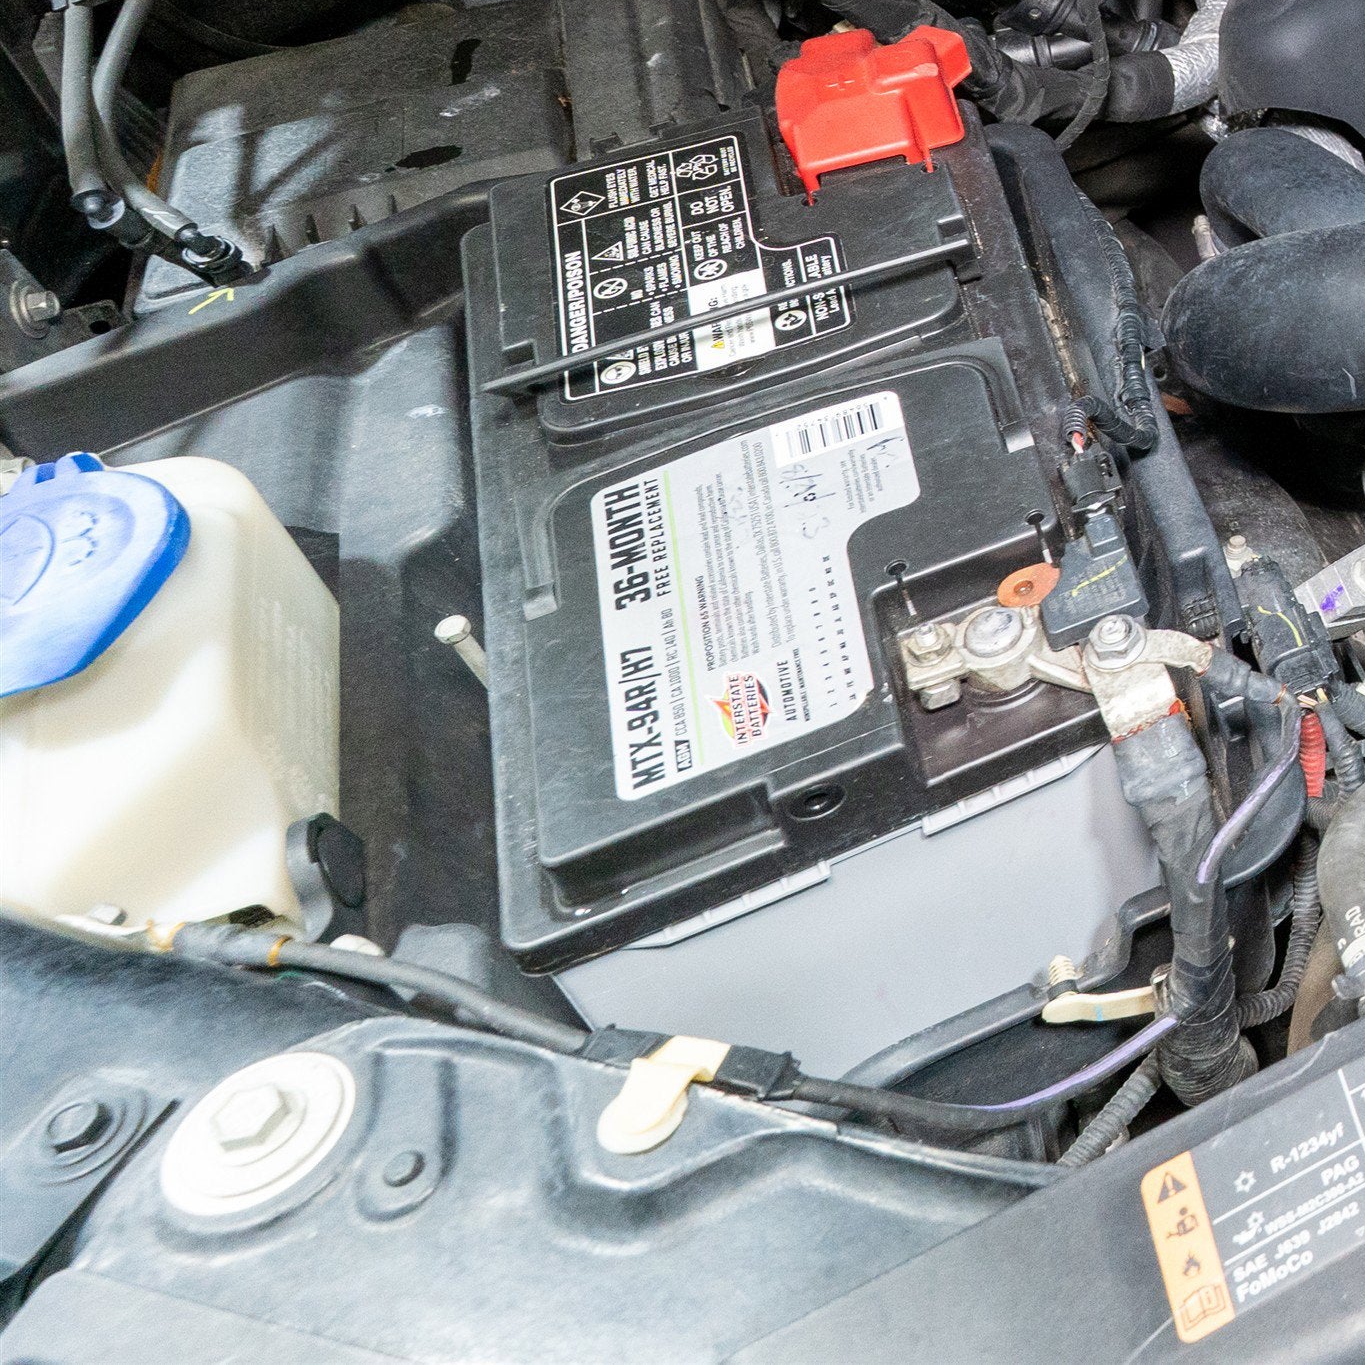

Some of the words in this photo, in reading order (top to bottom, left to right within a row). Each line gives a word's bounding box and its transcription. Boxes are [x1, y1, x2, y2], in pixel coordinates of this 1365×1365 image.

[605, 172, 615, 188] EYES
[627, 166, 637, 188] WATER.
[646, 159, 656, 185] MEDICAL
[607, 188, 617, 208] FLUSH
[616, 169, 629, 205] IMMEDIATELY
[629, 187, 639, 203] WITH
[649, 185, 658, 197] GET
[659, 179, 669, 195] HELP
[690, 201, 704, 215] DO
[704, 195, 718, 214] NOT
[719, 185, 734, 212] OPEN.
[650, 207, 660, 217] OR
[639, 220, 650, 240] CAUSE
[652, 217, 664, 251] BLINDNESS
[666, 223, 677, 247] SEVERE
[691, 231, 701, 243] OUT
[718, 223, 728, 231] OF
[732, 217, 745, 249] CHILDREN.
[641, 240, 651, 254] CAN
[705, 234, 716, 247] THE
[720, 230, 731, 253] REACH
[693, 244, 703, 260] KEEP
[707, 247, 718, 257] OF
[643, 266, 655, 291] SPARKS
[657, 262, 668, 288] FLAMES
[669, 254, 682, 284] SMOKING
[565, 251, 588, 352] DANGER/POISON
[650, 301, 660, 315] CAN
[826, 295, 839, 313] Lead
[678, 331, 689, 351] INJUR
[638, 352, 651, 375] SHIELD
[652, 340, 667, 370] EXPLOSIV
[667, 343, 679, 366] CAUSE
[681, 351, 692, 362] OR
[643, 479, 666, 561] REPLACEMENT
[605, 485, 650, 609] 36-MONTH
[654, 565, 670, 596] FREE
[695, 575, 706, 610] WARNING
[660, 608, 672, 619] 80
[662, 619, 673, 628] Ah
[700, 610, 709, 620] 65
[664, 634, 676, 649] 140
[701, 620, 714, 671] PROPOSITION
[665, 649, 677, 661] RC
[667, 666, 680, 686] 1000
[670, 685, 681, 697] CA
[777, 660, 796, 720] AUTOMOTIVE
[620, 646, 663, 787] MTX-94R/H7
[672, 702, 684, 719] 850
[729, 677, 746, 744] INTERSTATE
[743, 675, 761, 736] BATTERIES
[674, 718, 686, 736] CCA
[676, 740, 690, 770] AGM
[1270, 1122, 1343, 1172] R-1234yf
[1320, 1155, 1359, 1185] PAG
[1233, 1253, 1267, 1281] SAE
[1274, 1229, 1310, 1258] J639
[1236, 1250, 1312, 1301] FoMoCo
